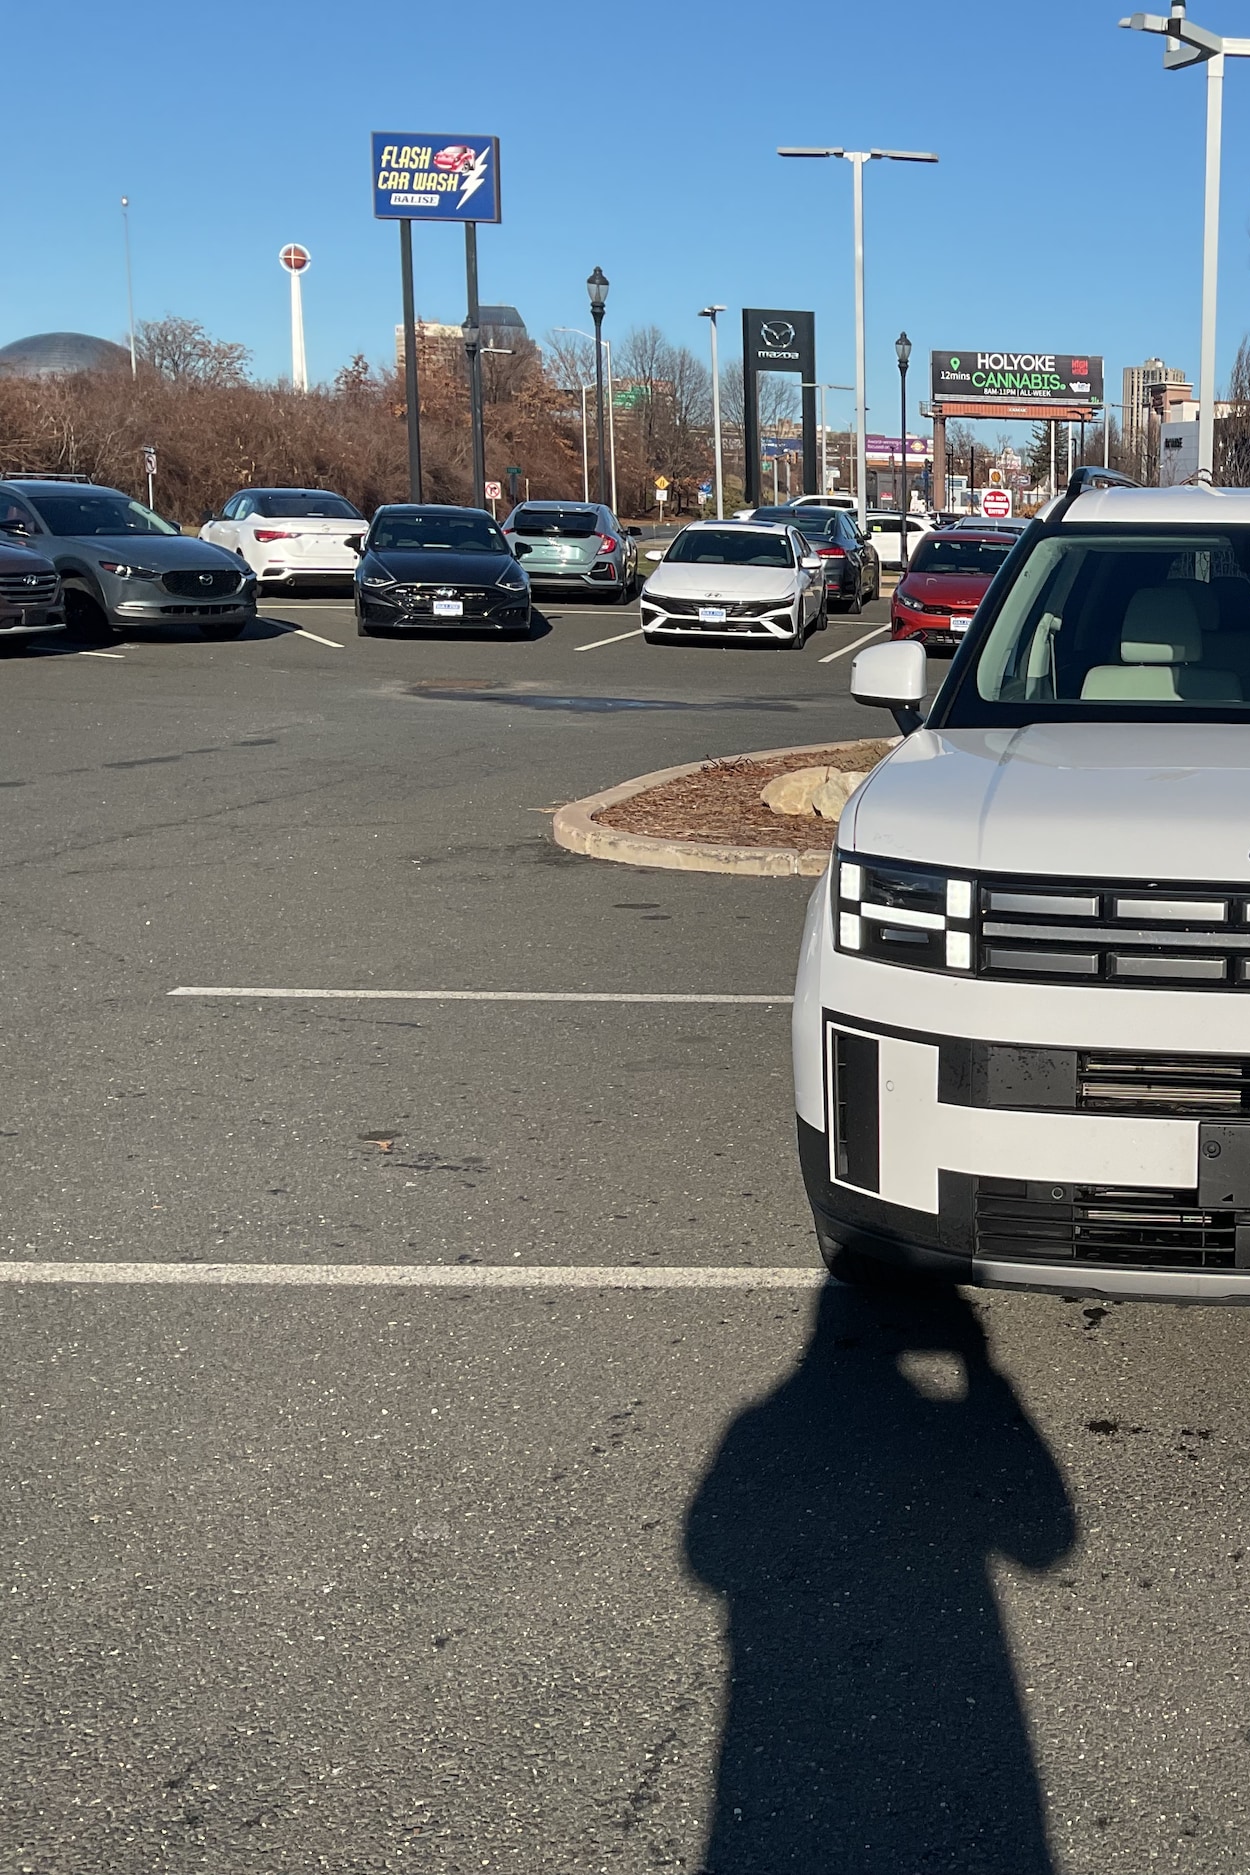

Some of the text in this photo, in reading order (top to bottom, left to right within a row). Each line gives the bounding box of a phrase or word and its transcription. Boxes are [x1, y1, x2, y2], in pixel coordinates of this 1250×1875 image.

[381, 145, 432, 169] FLASH
[378, 171, 459, 192] CAR WASH
[393, 195, 438, 205] BALISE
[977, 353, 1056, 372] HOLYOKE
[940, 371, 971, 381] 12mins
